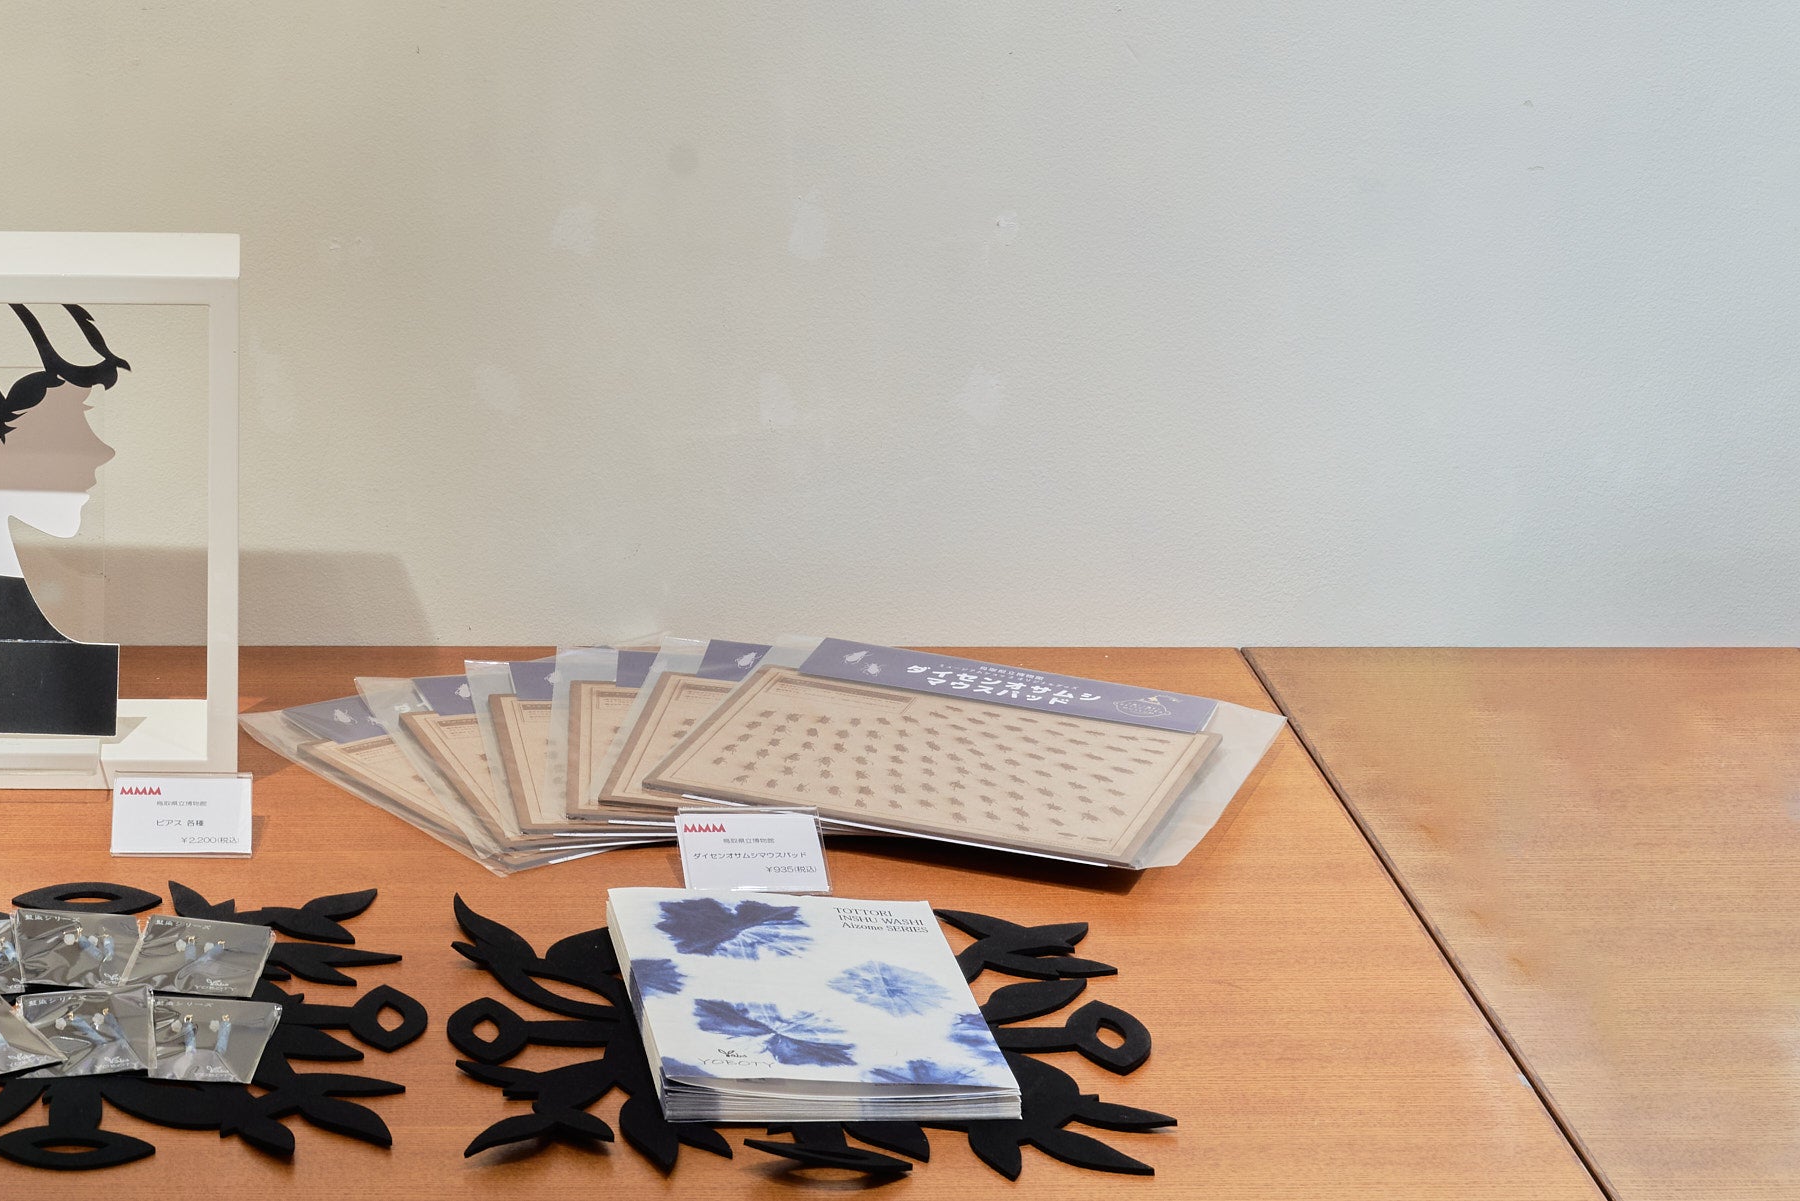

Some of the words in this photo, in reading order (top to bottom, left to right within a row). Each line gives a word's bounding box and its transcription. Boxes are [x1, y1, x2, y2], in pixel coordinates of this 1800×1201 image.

[906, 665, 1102, 702] ダイセンオサムシ
[927, 677, 1070, 705] マウスパッド
[833, 907, 892, 917] TOTTORI
[838, 914, 878, 924] INSHU
[881, 918, 924, 926] WASHI
[842, 921, 883, 931] Aizome
